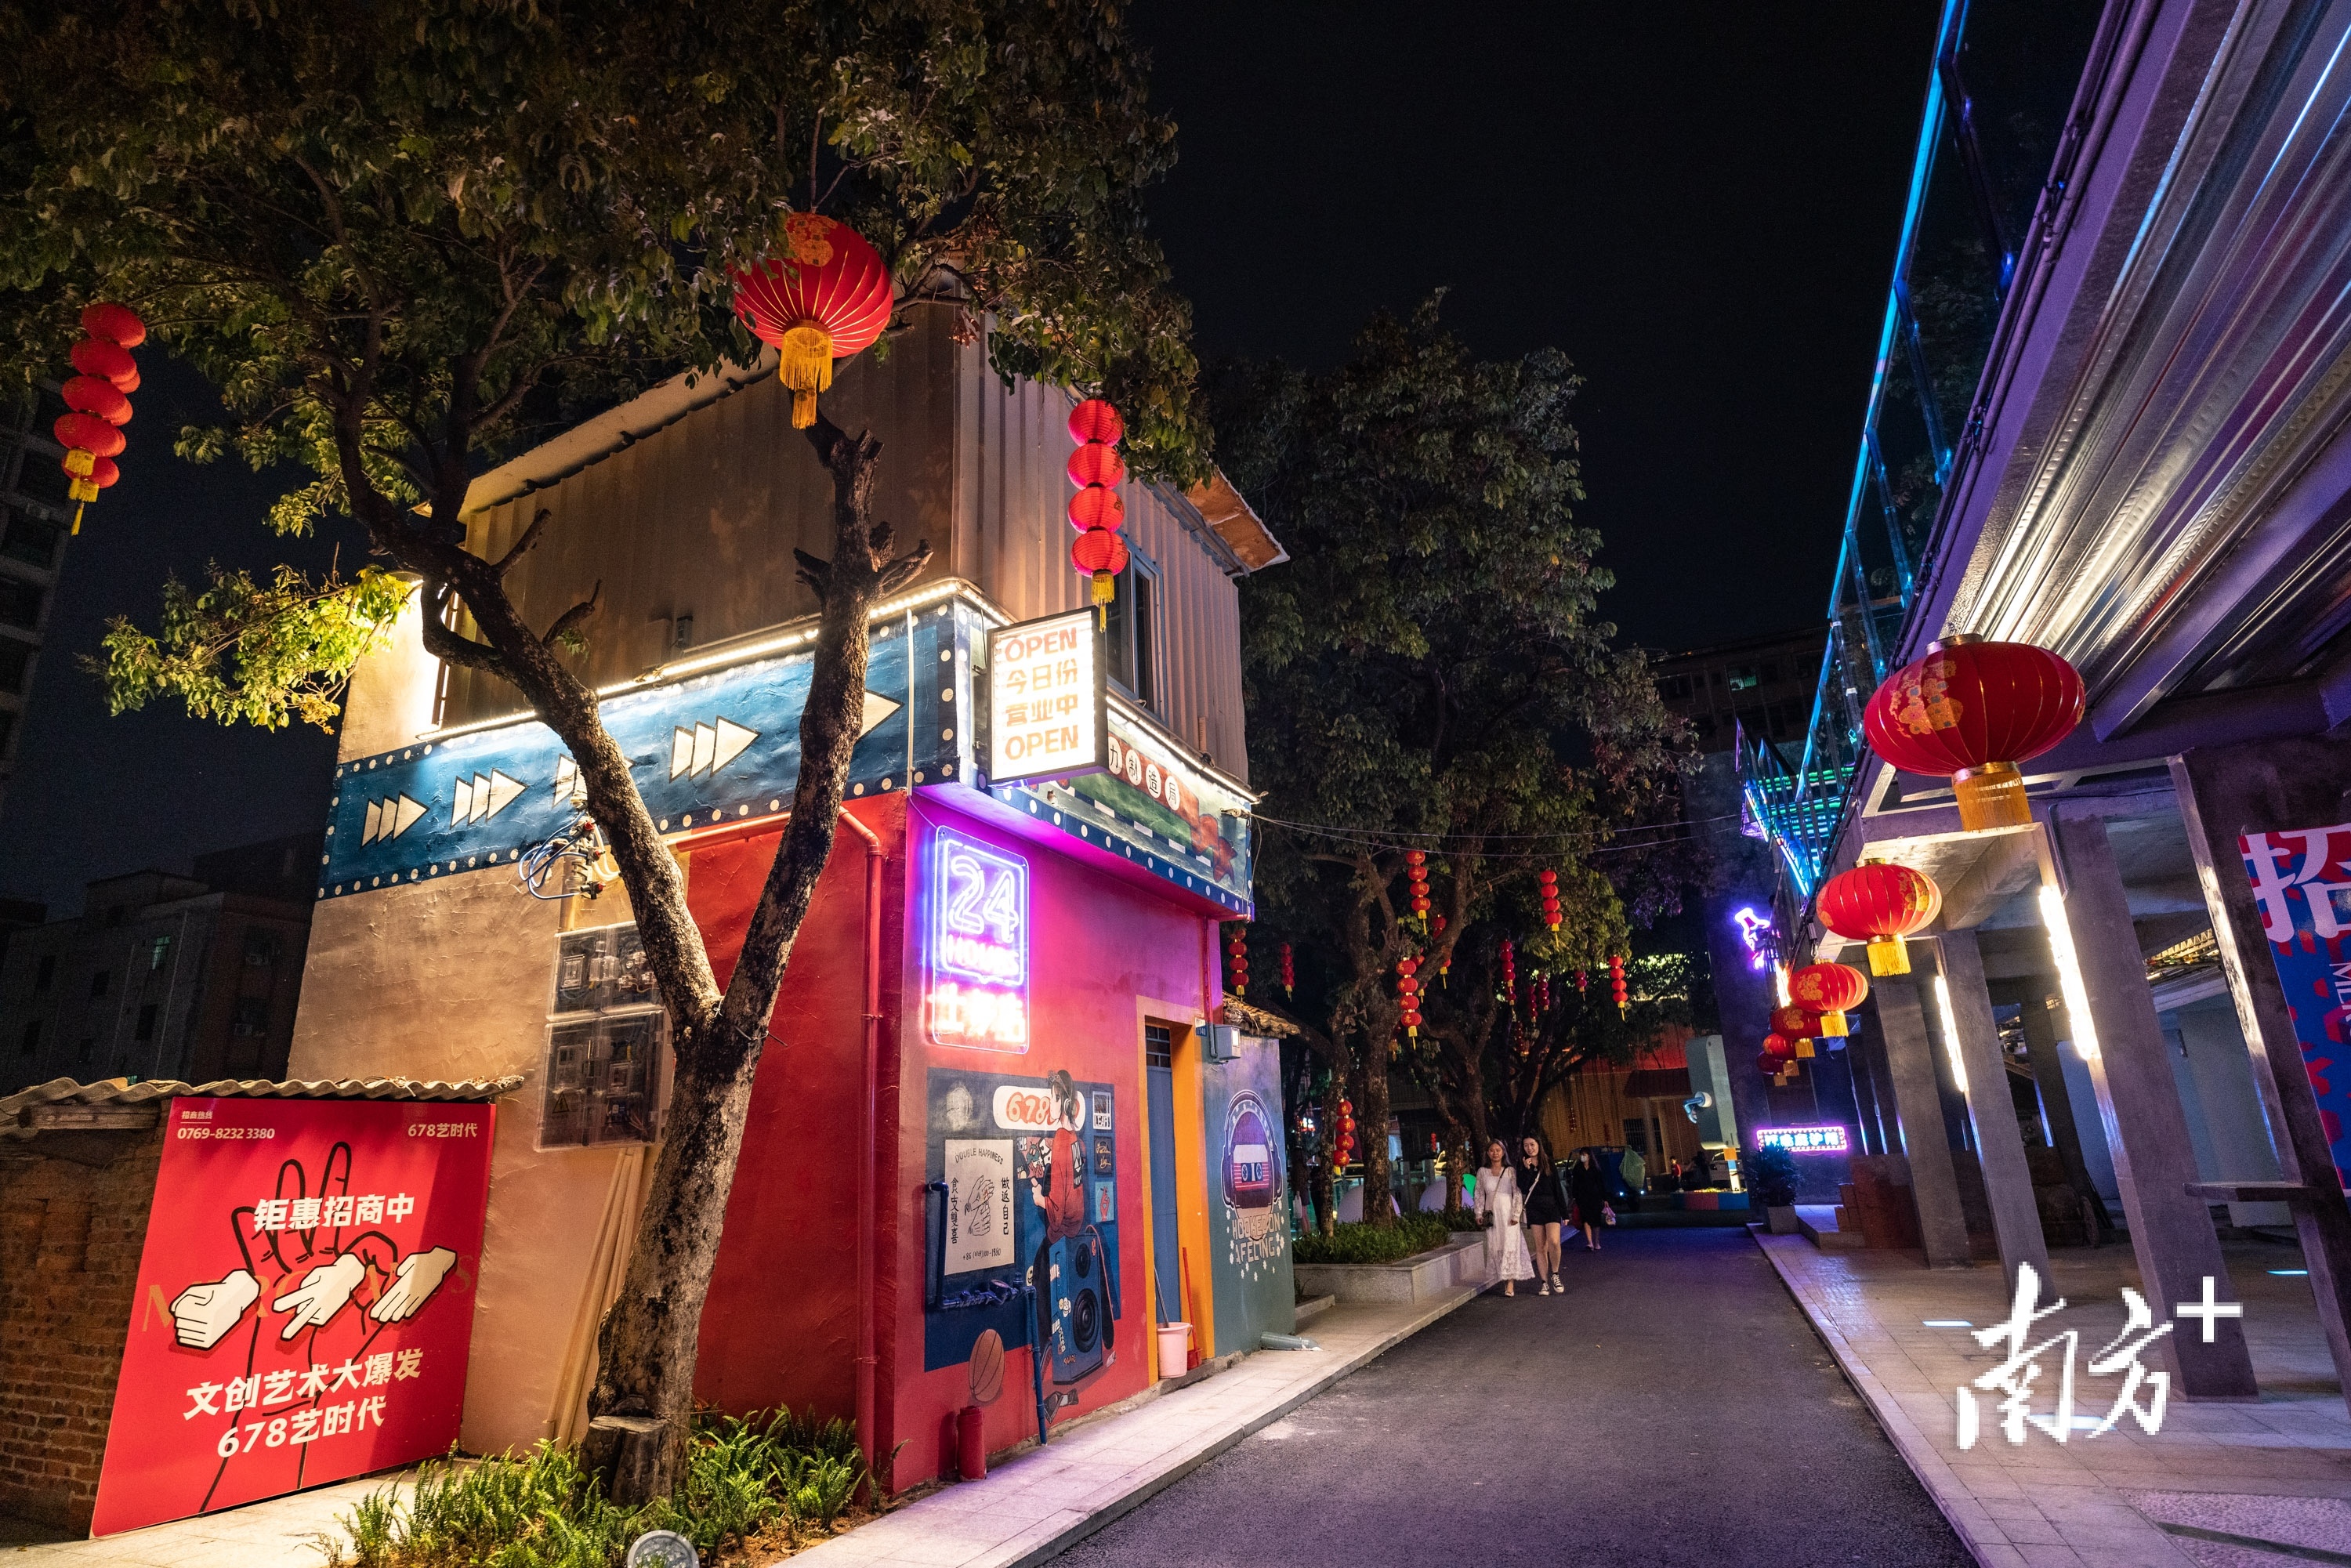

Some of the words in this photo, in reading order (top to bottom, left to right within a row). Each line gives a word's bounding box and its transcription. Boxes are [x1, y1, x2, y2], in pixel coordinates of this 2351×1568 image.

[1005, 627, 1078, 662] OPEN
[1006, 658, 1078, 694] 今日份
[1005, 693, 1078, 726] 营业中
[1005, 725, 1078, 760] OPEN
[948, 854, 1019, 943] 24
[181, 1110, 213, 1120] 招商热线
[408, 1123, 478, 1138] 678艺时代
[246, 1128, 275, 1139] 3380
[955, 1148, 976, 1164] DOUBLE
[978, 1148, 1004, 1165] HAPPINESS
[252, 1193, 415, 1231] 钜惠招商中
[1001, 1177, 1010, 1235] 做返自己
[182, 1348, 424, 1420] 文创艺术大爆发
[217, 1395, 386, 1458] 678艺时代
